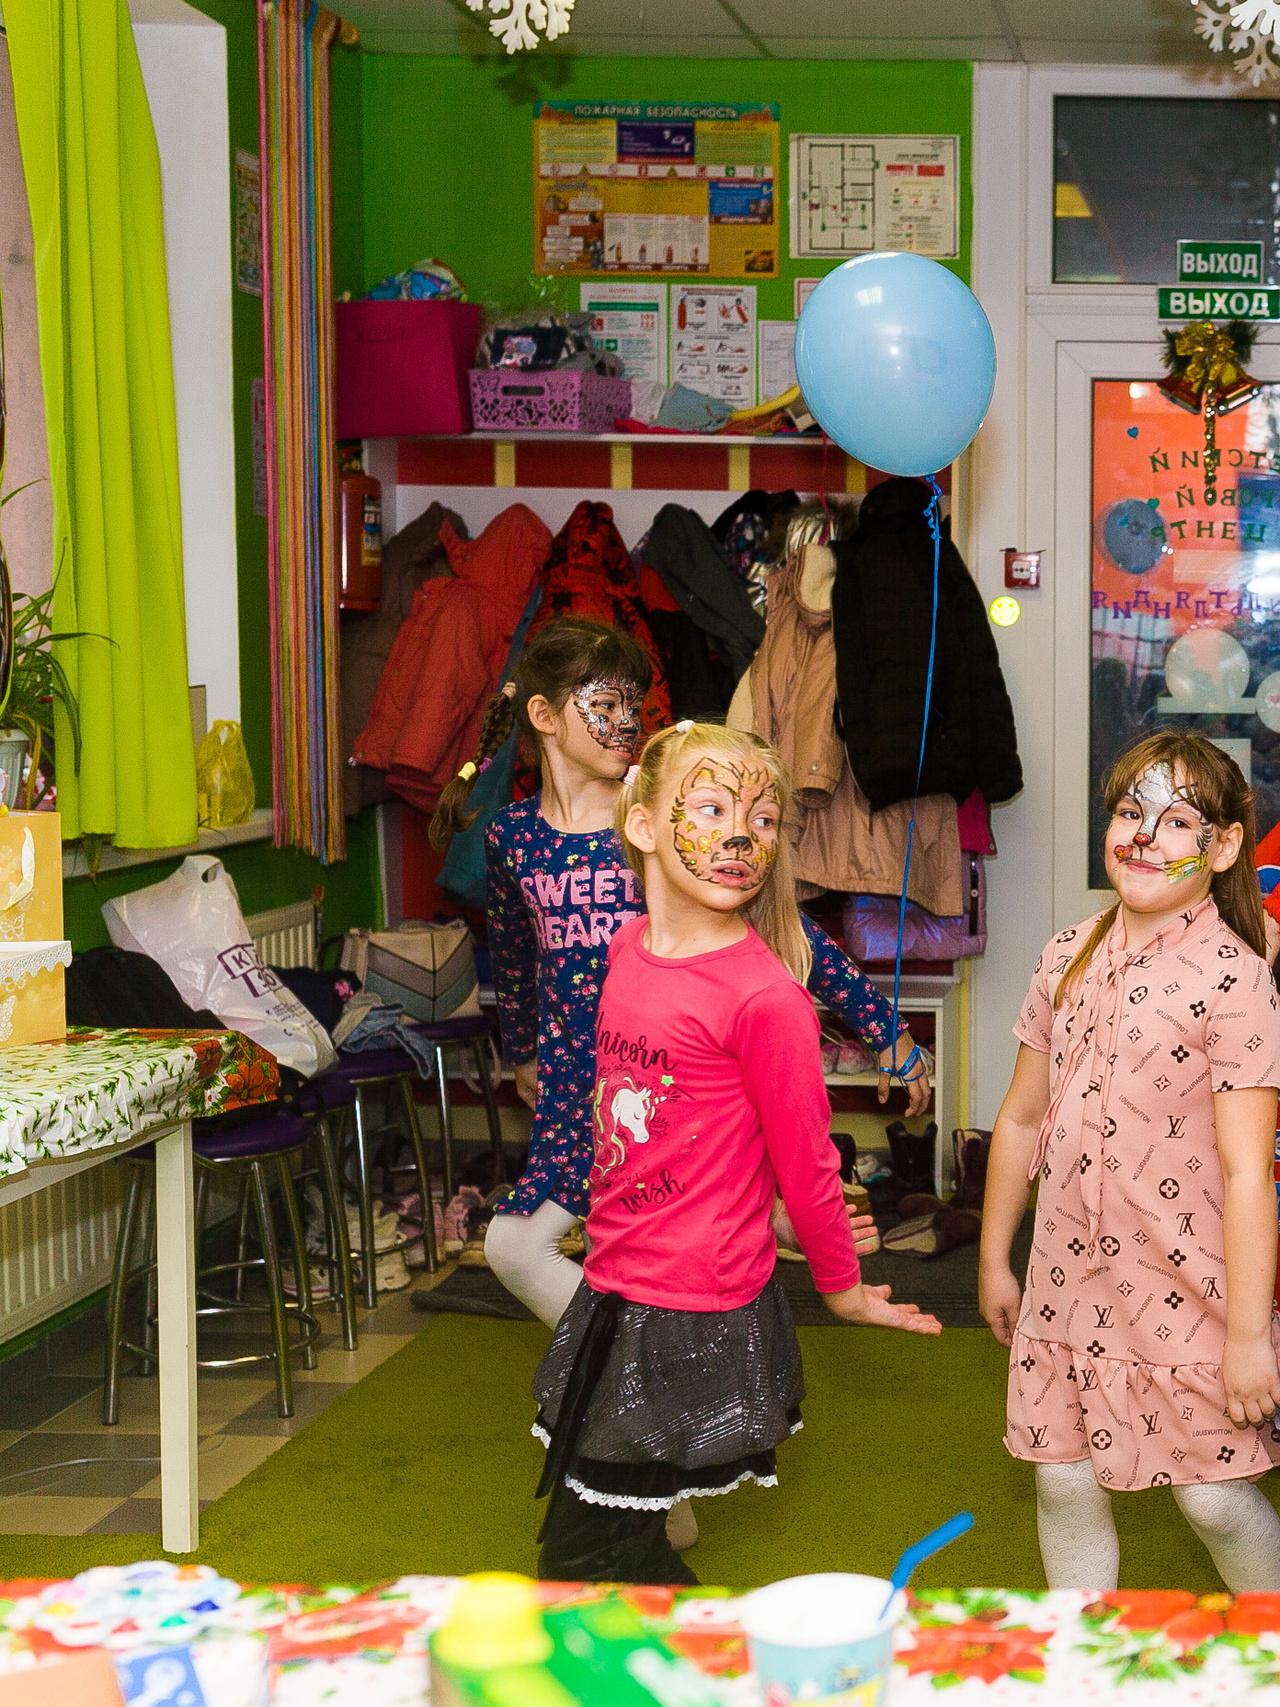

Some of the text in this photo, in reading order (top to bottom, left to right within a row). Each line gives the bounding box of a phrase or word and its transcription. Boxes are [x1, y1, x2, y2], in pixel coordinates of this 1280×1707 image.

[574, 105, 737, 118] ПОЖАРНАЯ БЕЗОПАСНОСТЬ
[1183, 253, 1258, 278] ВЫХОД
[1170, 292, 1270, 317] ВЫХОД
[519, 868, 637, 909] SWEET
[1118, 1094, 1151, 1124] LOUISVUITTON
[1132, 1144, 1156, 1182] LOUISVUITTON
[619, 1168, 685, 1214] wish
[1123, 1197, 1161, 1223] LOUISVUITTON
[1137, 1258, 1178, 1281] LOUISVUITTON
[1192, 1428, 1233, 1438] LOUISVUITTON
